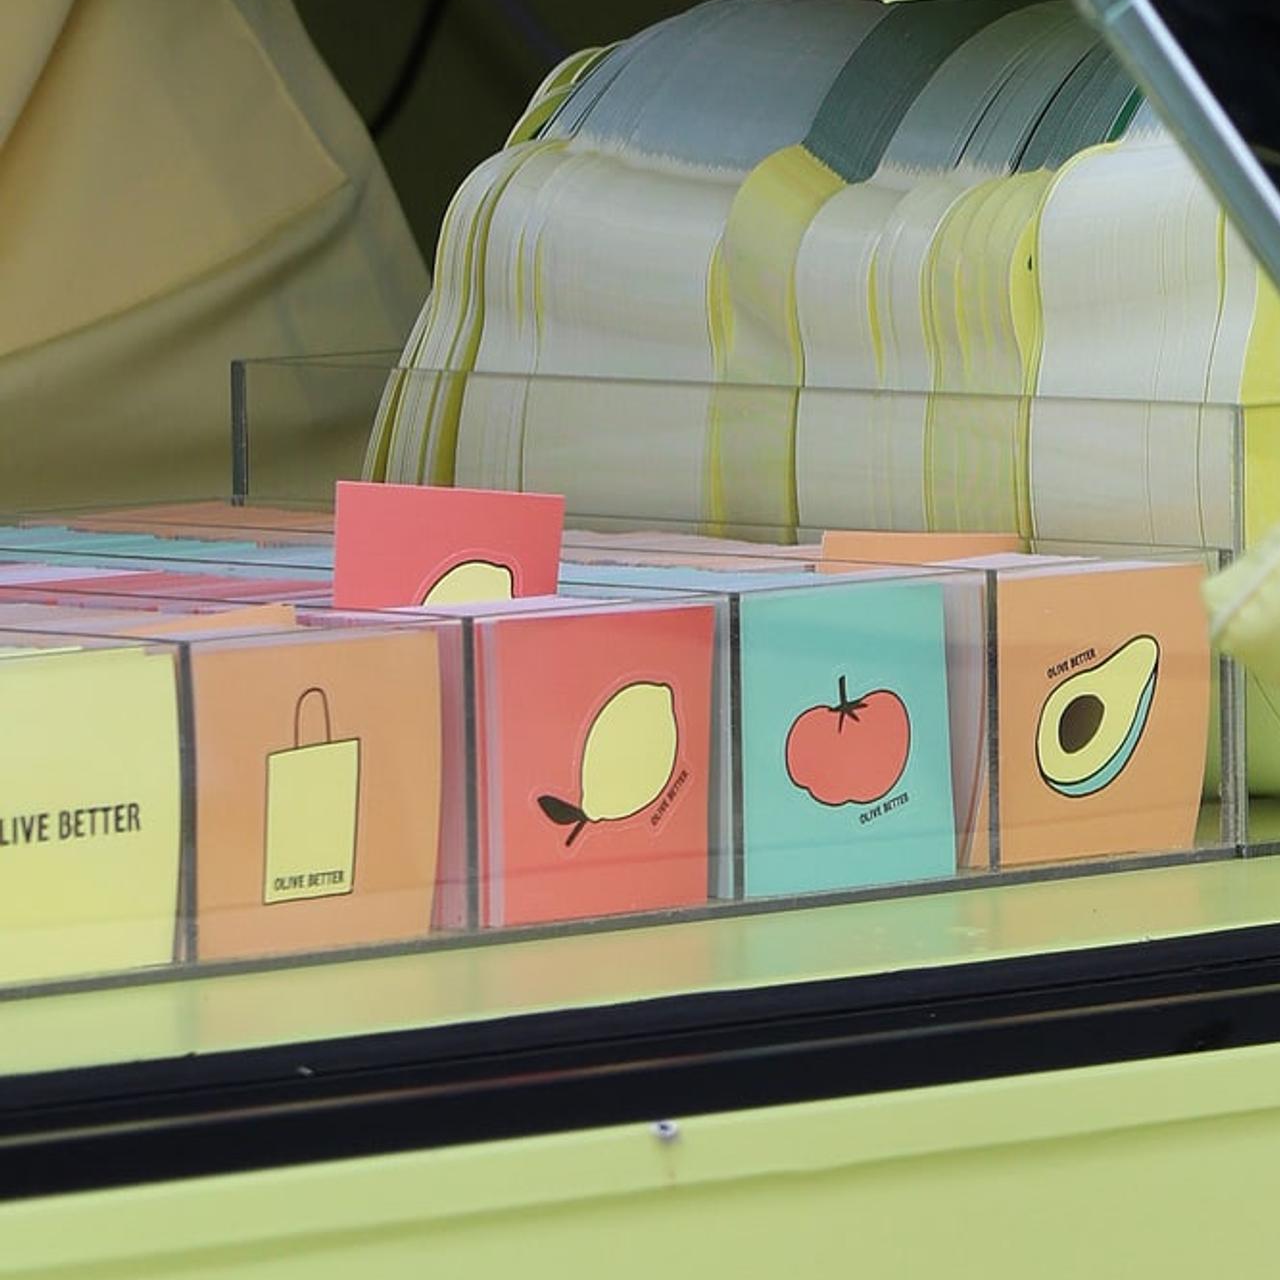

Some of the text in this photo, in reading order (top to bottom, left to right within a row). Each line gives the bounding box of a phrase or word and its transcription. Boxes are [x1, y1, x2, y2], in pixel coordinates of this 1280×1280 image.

[1046, 648, 1096, 679] OLIVE BETTER
[0, 802, 141, 846] LIVE BETTER
[859, 792, 909, 825] OLIVE BETTER
[274, 874, 304, 891] OLIVE
